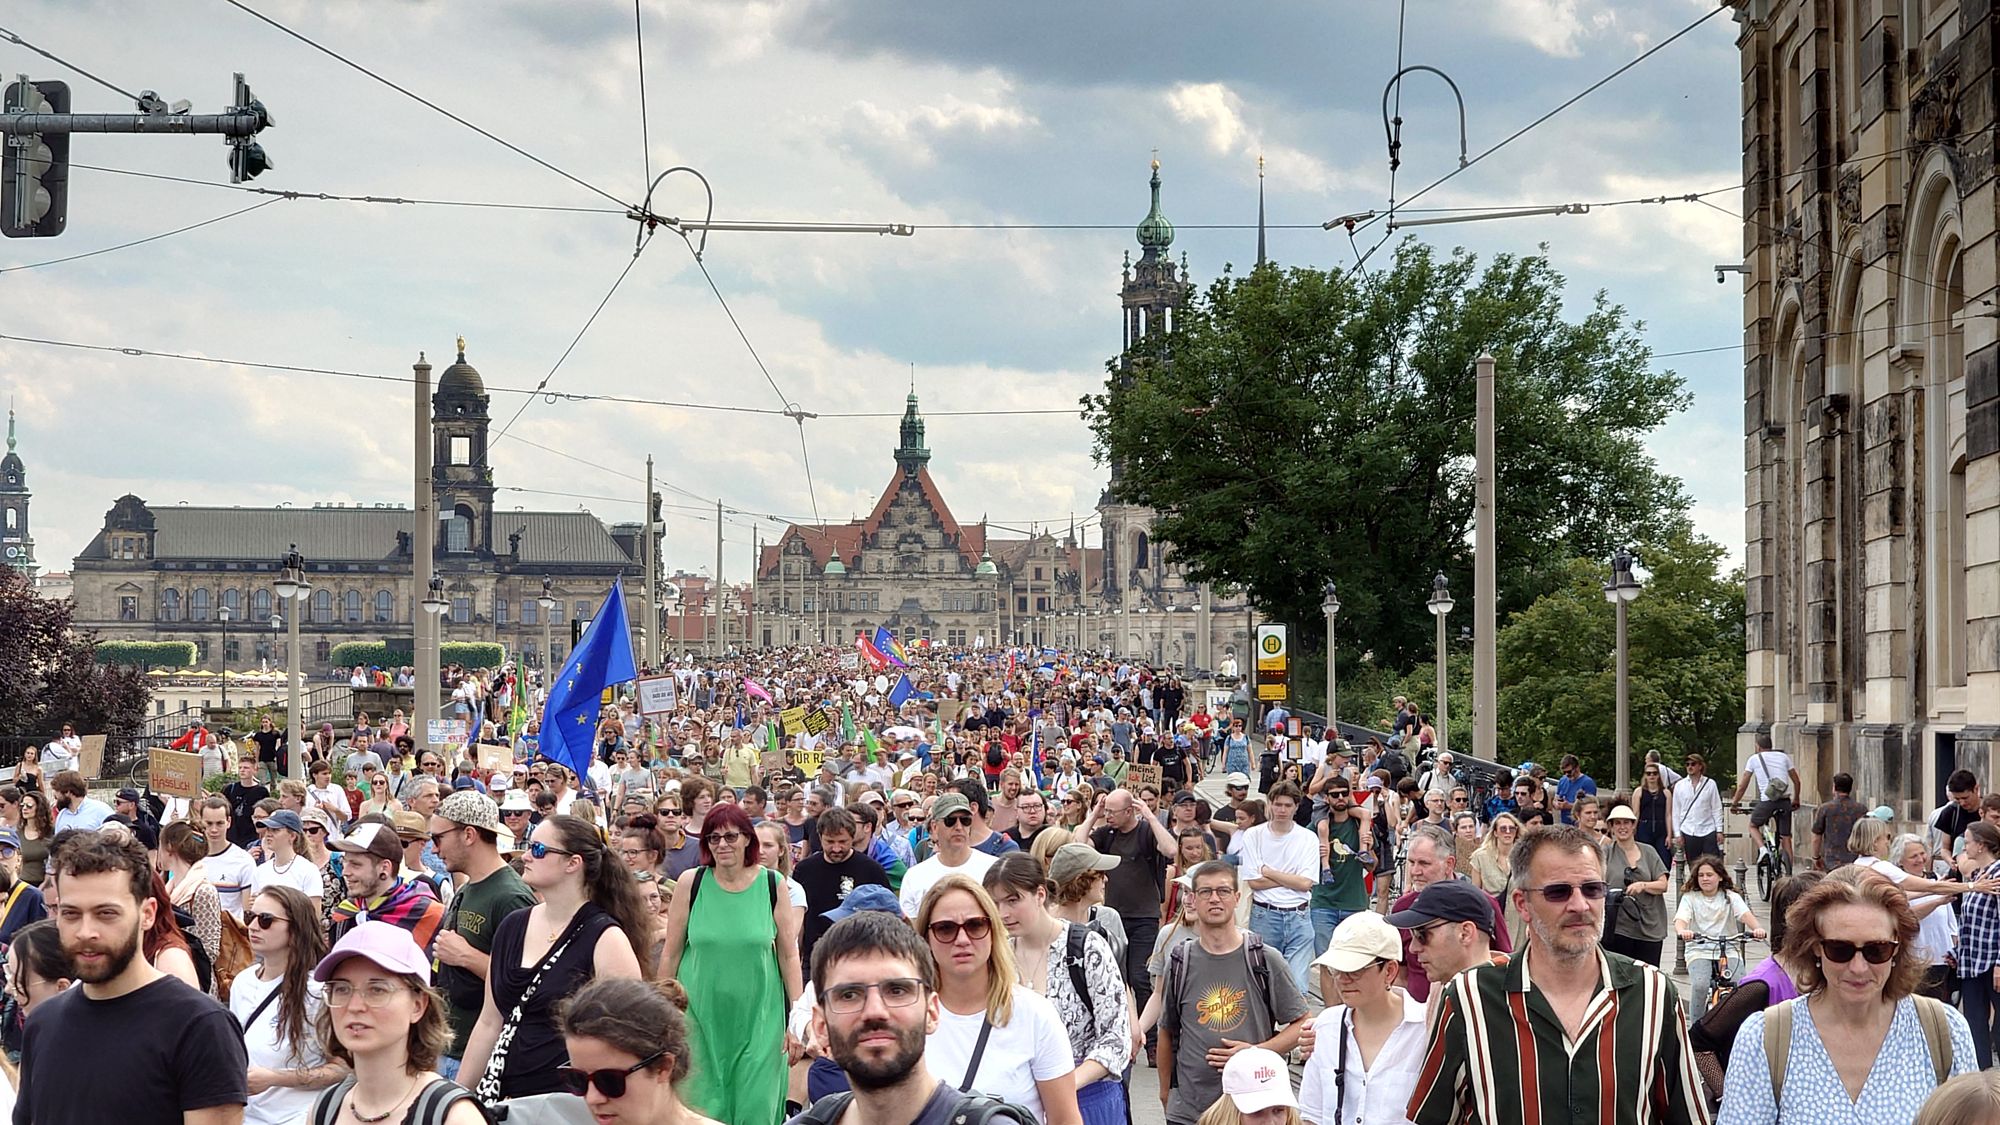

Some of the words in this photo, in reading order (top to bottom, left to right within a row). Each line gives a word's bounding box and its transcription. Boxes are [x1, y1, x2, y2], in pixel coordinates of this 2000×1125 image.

[1267, 639, 1277, 650] H
[153, 751, 188, 772] HASS
[796, 751, 810, 764] ÜR
[458, 910, 486, 935] ORK
[1254, 1066, 1276, 1080] nike
